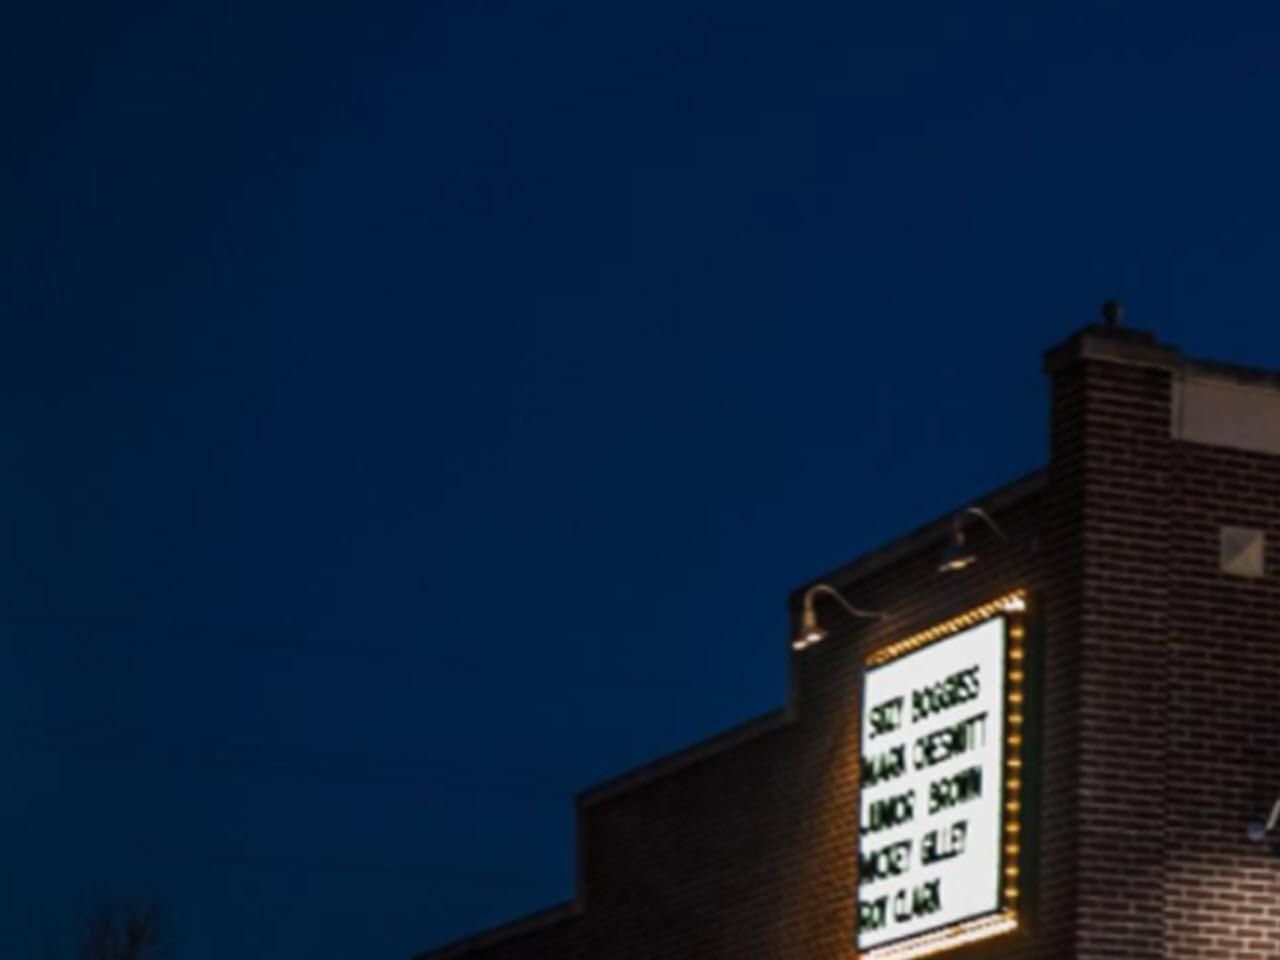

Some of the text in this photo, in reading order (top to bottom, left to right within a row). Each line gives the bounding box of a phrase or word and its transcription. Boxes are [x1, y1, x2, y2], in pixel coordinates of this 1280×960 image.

[928, 766, 982, 815] BROWN
[920, 819, 968, 867] GILLEY
[857, 877, 941, 933] ROY CLARK
